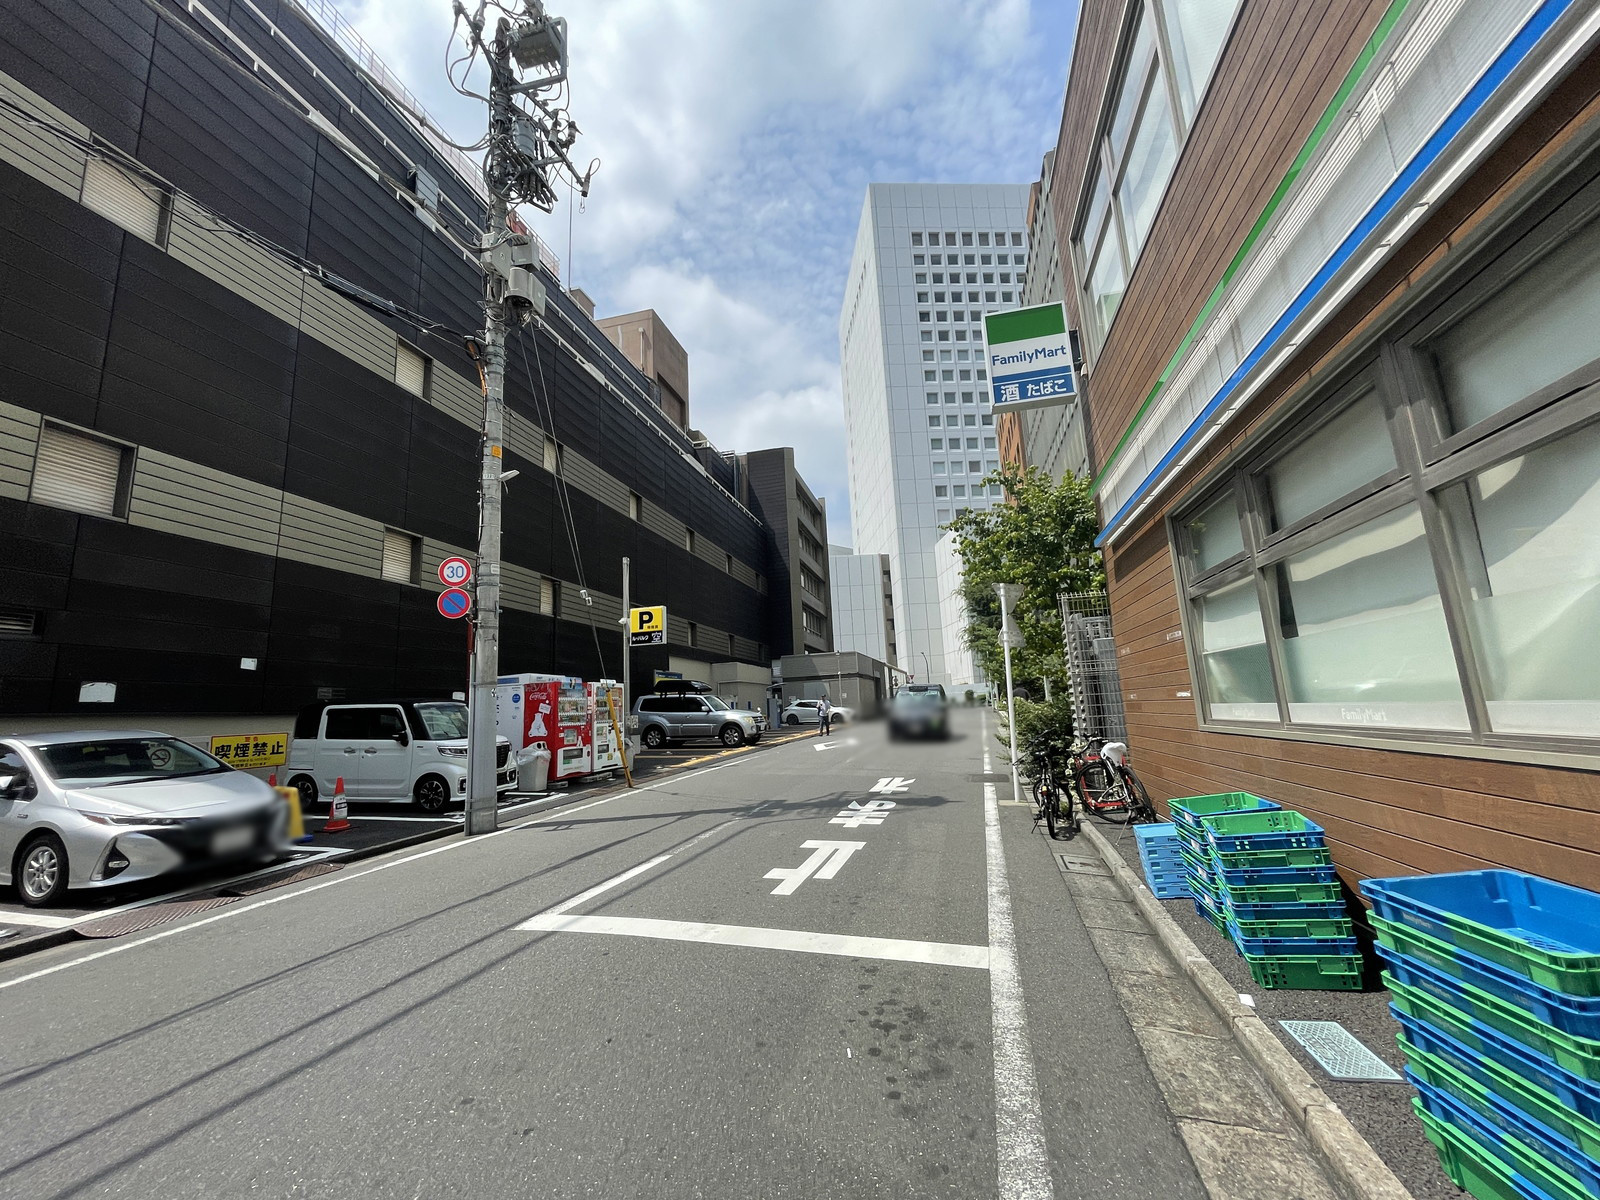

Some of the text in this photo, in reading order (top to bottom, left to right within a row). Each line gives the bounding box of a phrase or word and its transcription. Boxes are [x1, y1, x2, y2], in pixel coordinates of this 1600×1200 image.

[991, 344, 1067, 366] FamilyMart
[1000, 379, 1067, 402] 酒 たばこ
[446, 565, 465, 579] 30
[638, 611, 654, 630] P
[1341, 708, 1387, 724] FamilyMart
[214, 740, 285, 760] 喫煙禁止
